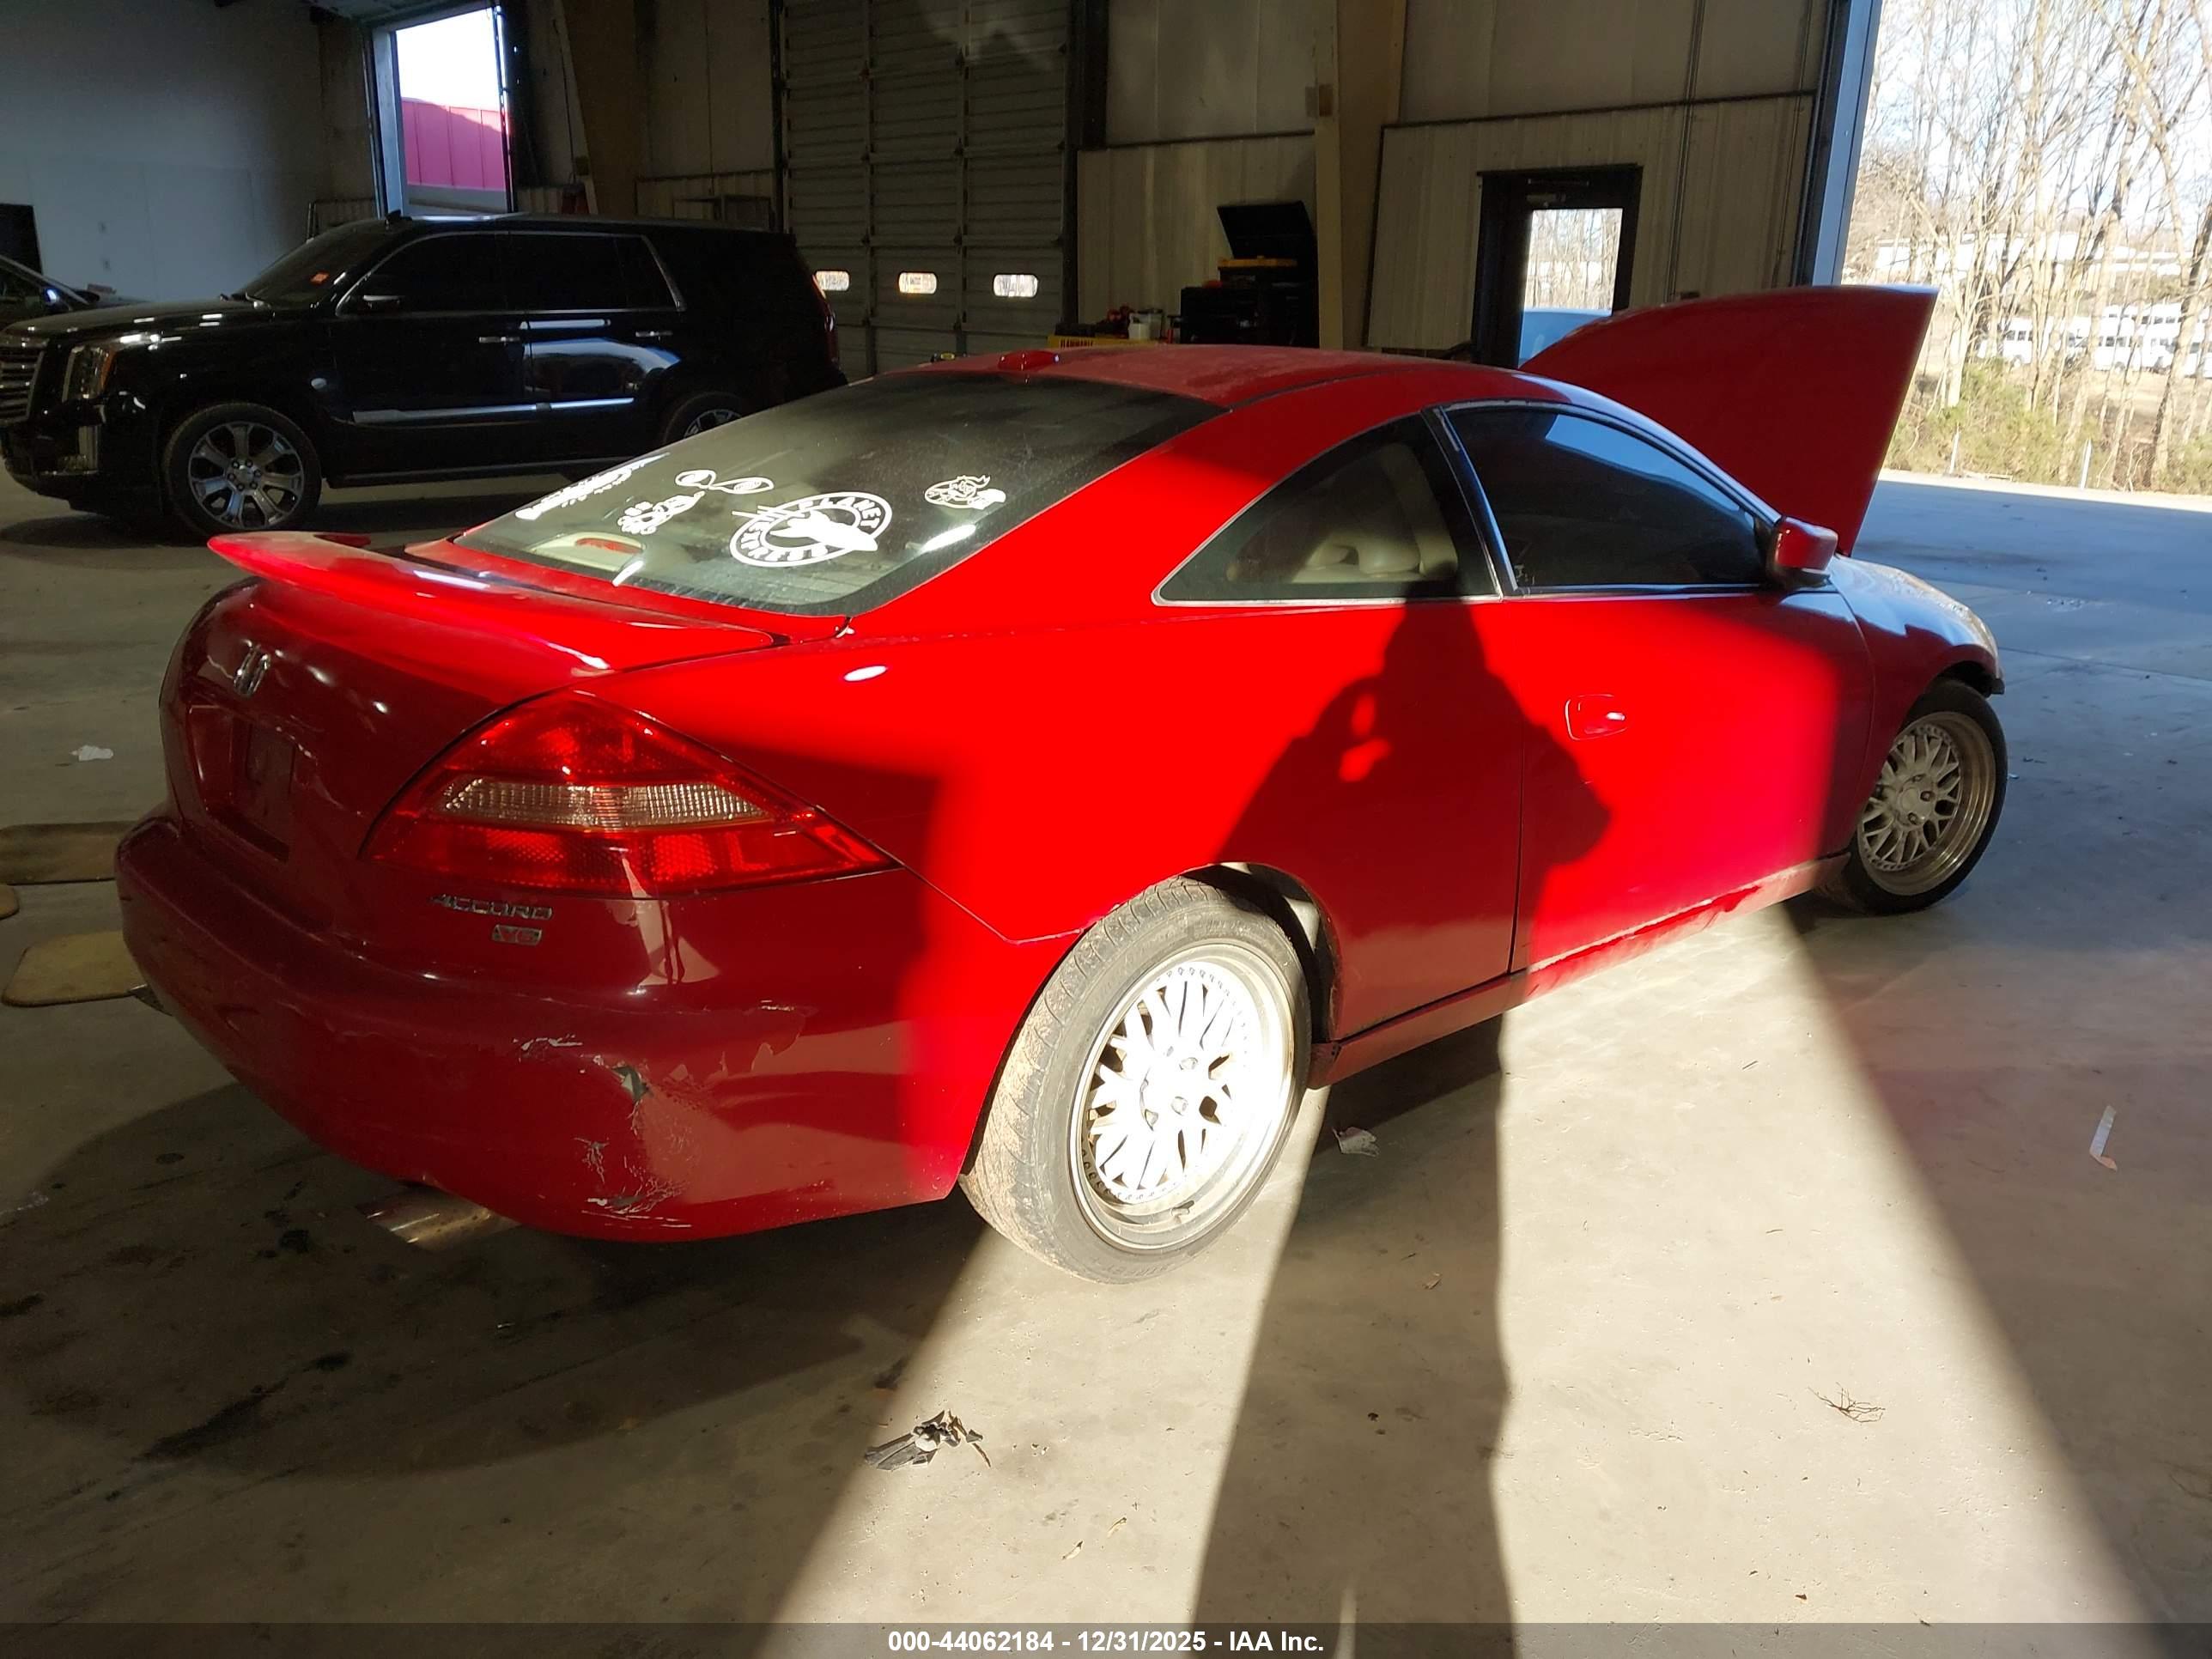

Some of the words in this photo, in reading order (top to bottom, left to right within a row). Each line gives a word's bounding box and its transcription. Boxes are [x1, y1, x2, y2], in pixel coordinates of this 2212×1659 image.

[798, 496, 882, 529] PLANET
[431, 893, 553, 921] ACCORD
[492, 924, 543, 946] V6
